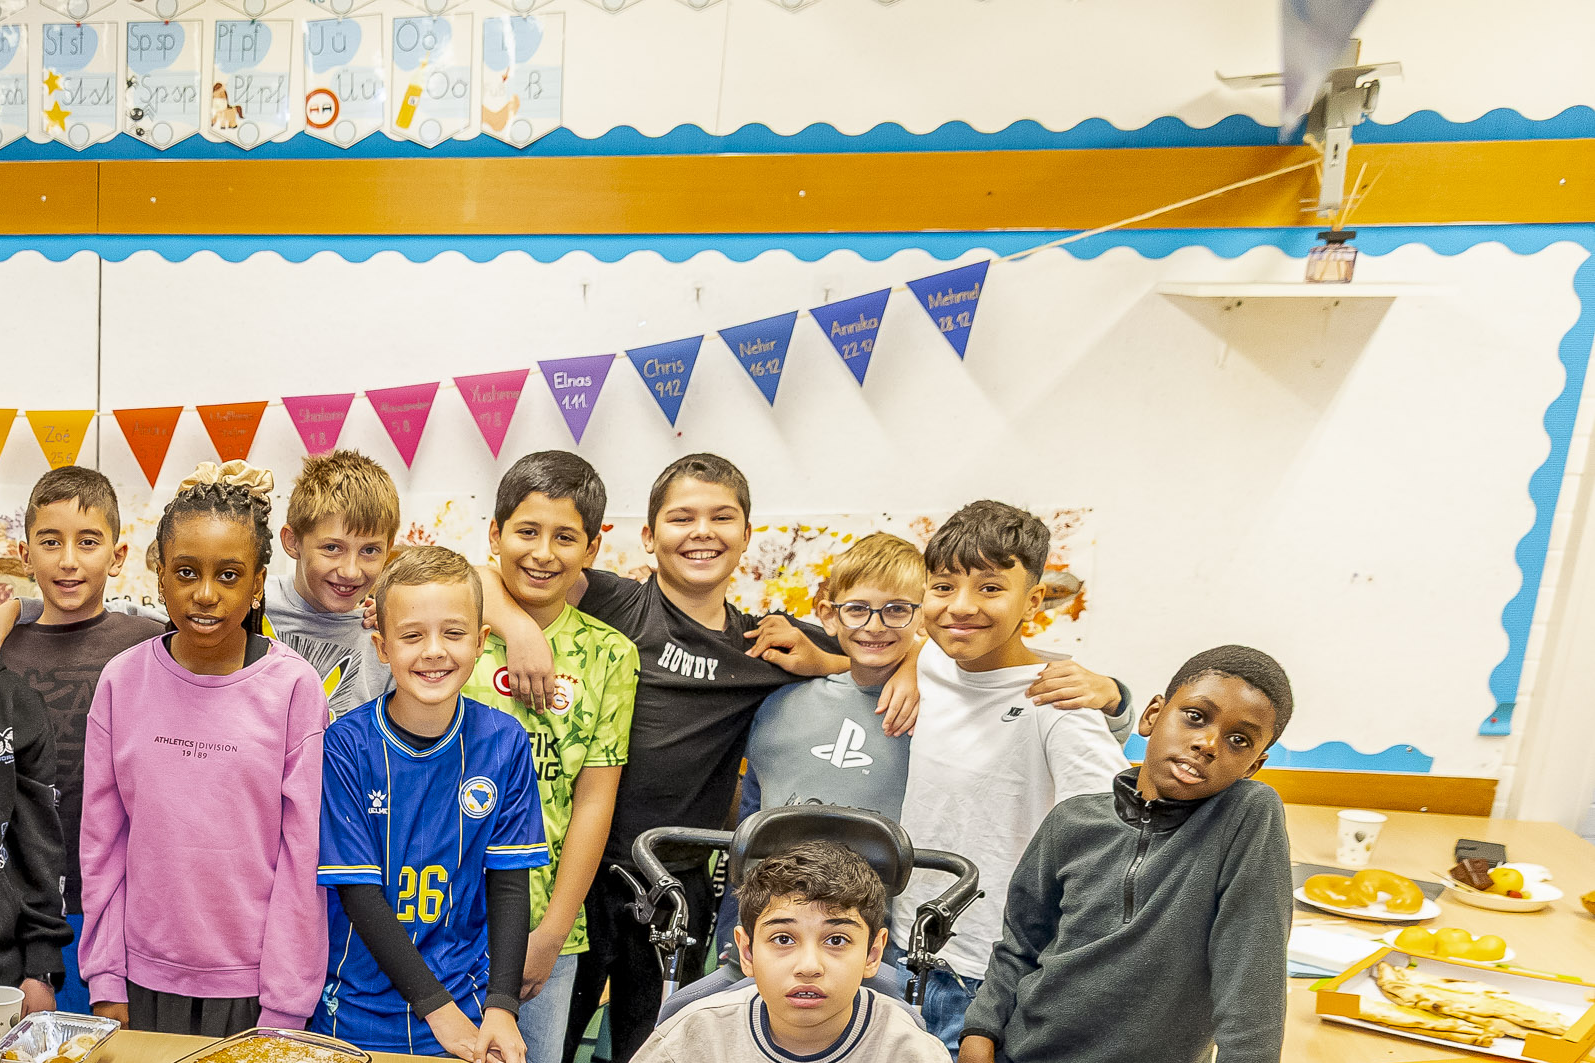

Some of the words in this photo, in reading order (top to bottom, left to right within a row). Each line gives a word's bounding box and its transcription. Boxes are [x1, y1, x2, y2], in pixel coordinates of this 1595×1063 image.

[130, 25, 152, 61] Sp
[157, 34, 175, 61] sp
[553, 371, 592, 389] Elnas
[643, 357, 685, 378] Chris
[657, 641, 719, 681] HOWDY
[154, 736, 194, 748] ATHLETICS
[199, 742, 238, 752] DIVISION
[396, 865, 448, 924] 26
